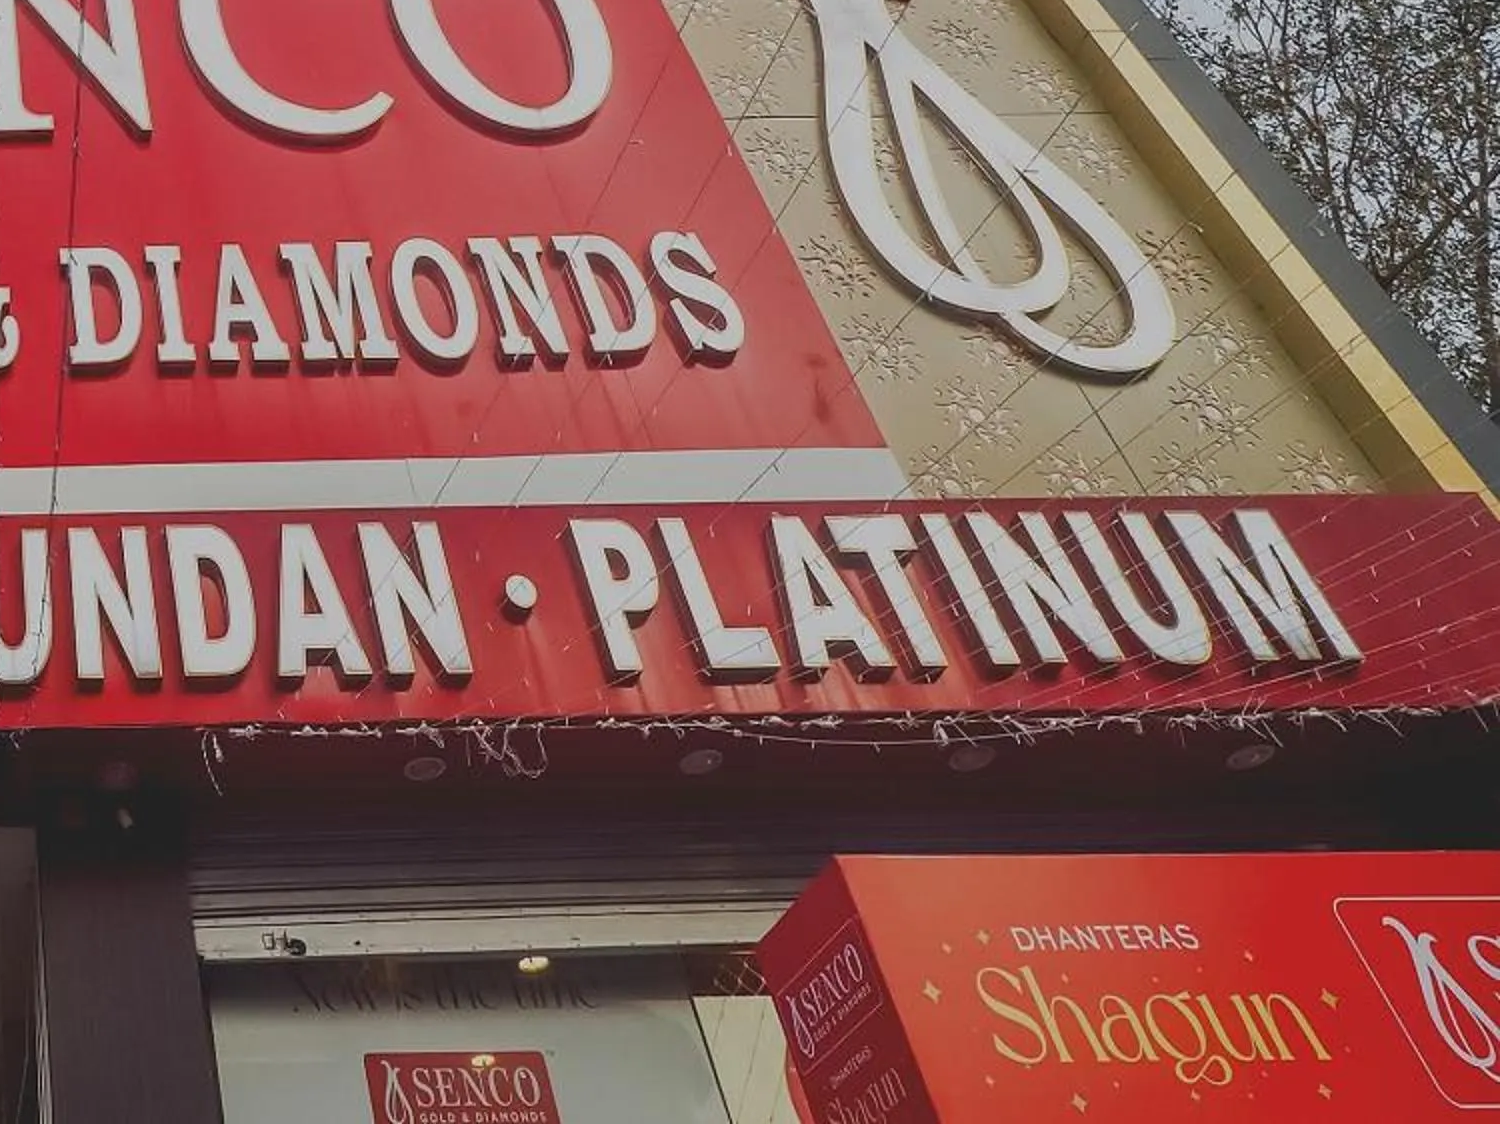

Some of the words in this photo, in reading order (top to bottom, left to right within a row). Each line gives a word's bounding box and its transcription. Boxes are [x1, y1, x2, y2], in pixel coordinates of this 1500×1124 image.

[58, 231, 746, 371] DIAMONDS
[568, 507, 1364, 684] PLATINUM
[1010, 922, 1201, 953] DHANTERAS
[800, 942, 864, 1027] SENCO
[975, 965, 1333, 1086] Shagun
[411, 1066, 542, 1108] SENCO
[419, 1111, 456, 1124] GOLD
[461, 1111, 470, 1124] &
[475, 1110, 548, 1124] DIAMONDS
